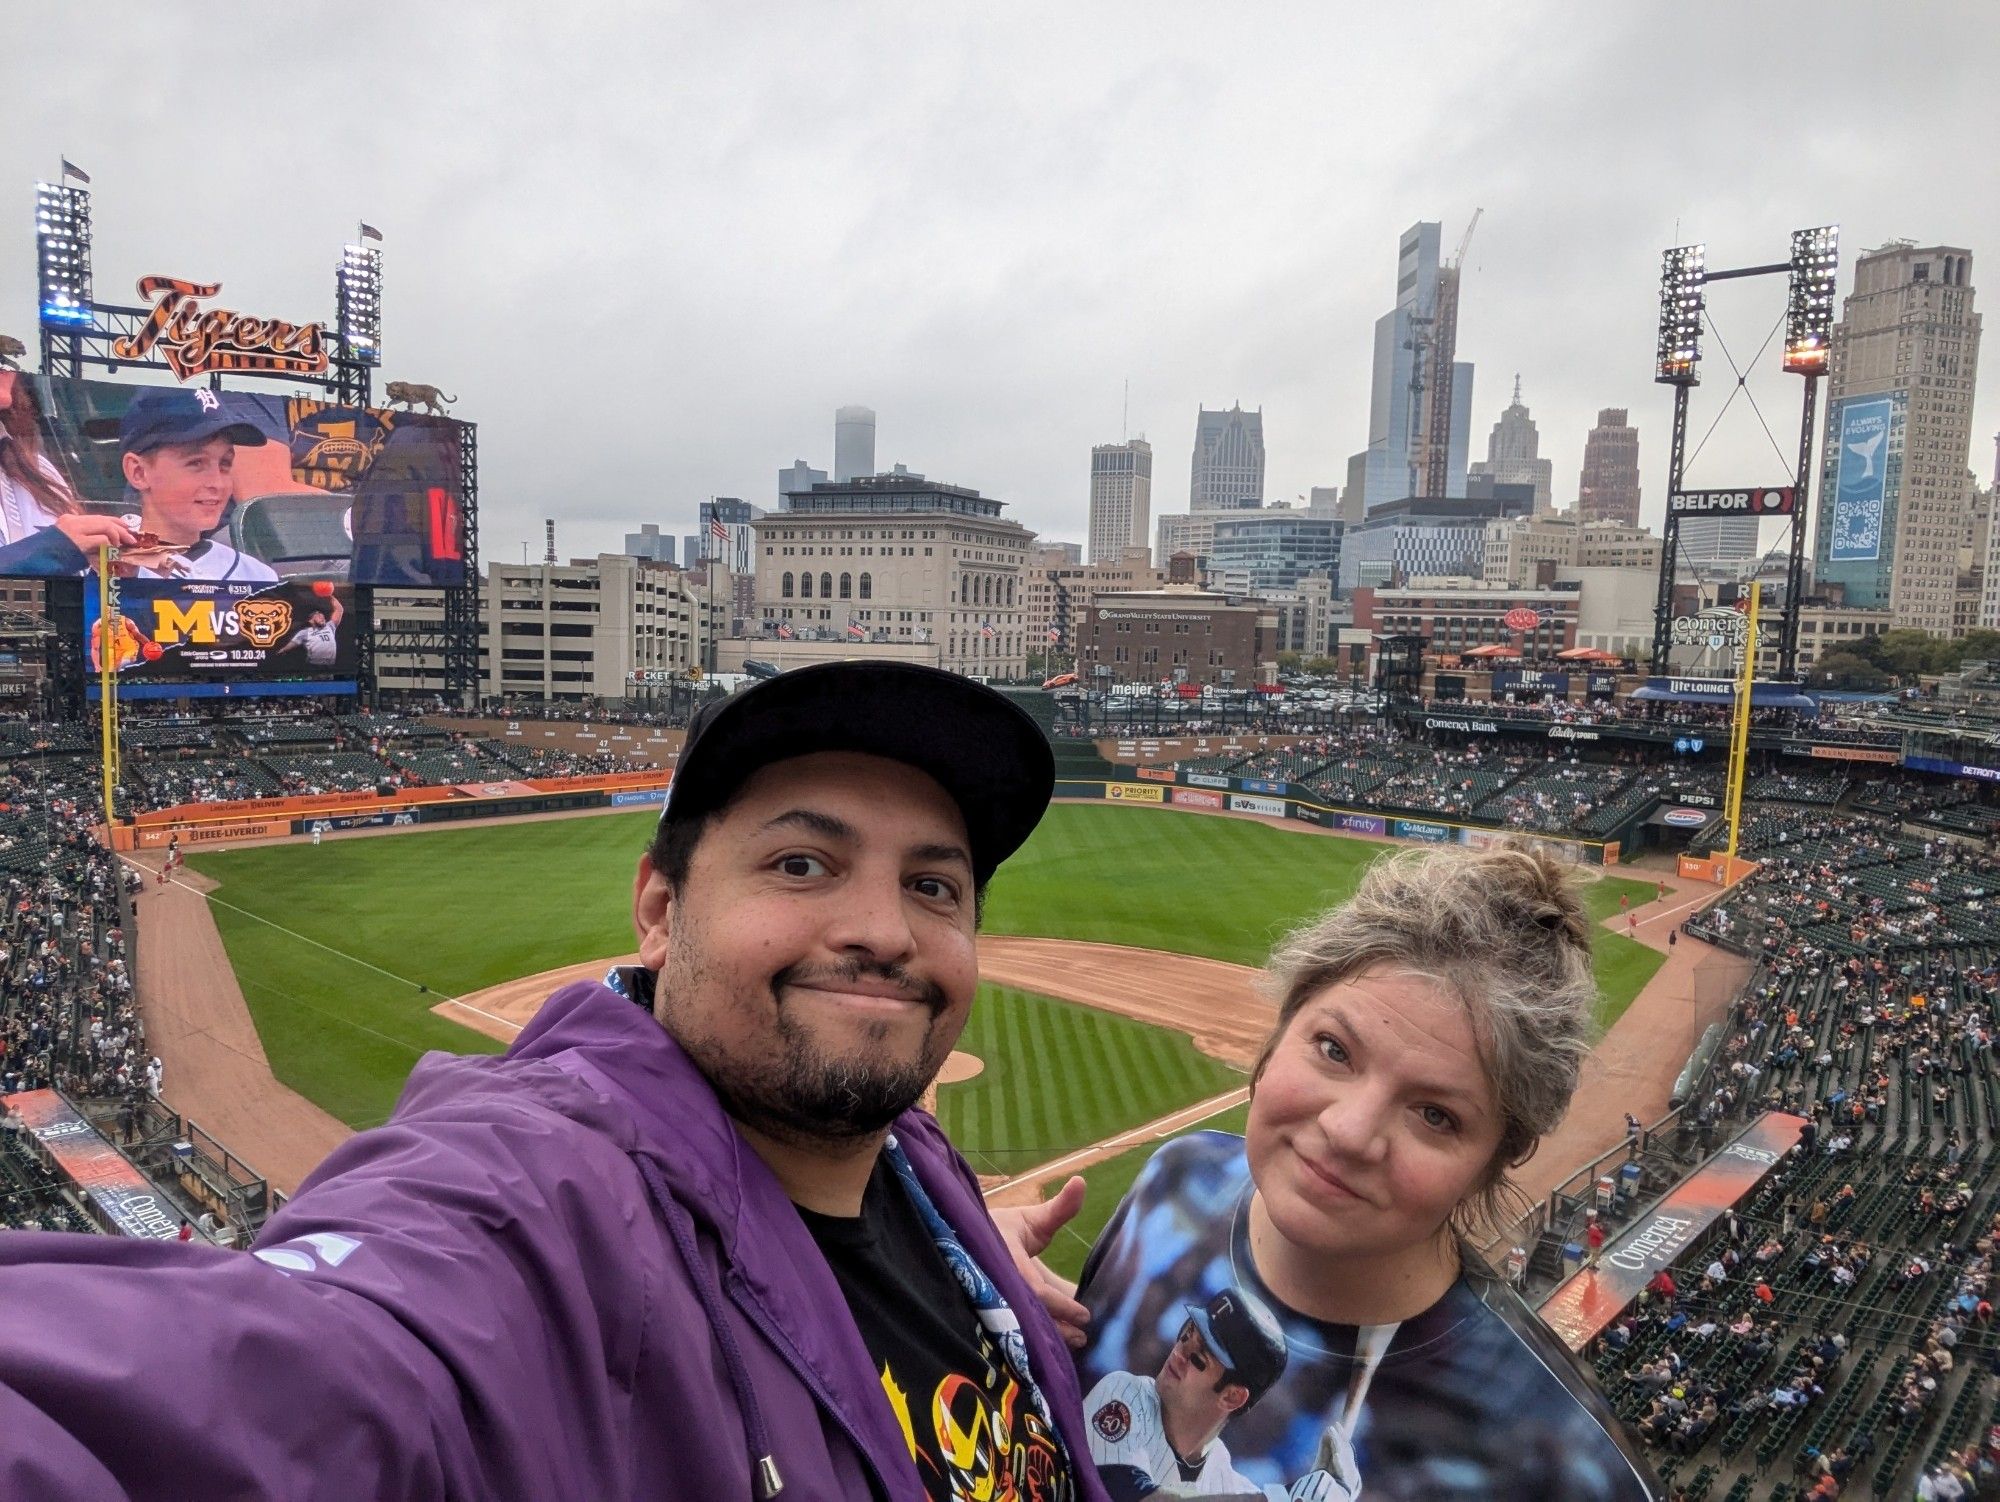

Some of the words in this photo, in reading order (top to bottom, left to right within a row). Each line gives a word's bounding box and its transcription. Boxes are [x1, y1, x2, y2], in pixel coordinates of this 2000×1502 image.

[113, 274, 325, 367] Tigers
[1672, 493, 1749, 510] BELFOR
[153, 600, 216, 643] M
[210, 611, 239, 636] VS
[231, 650, 266, 660] 10.20.24
[628, 671, 670, 680] ROCKET
[1521, 670, 1543, 684] Lite
[1112, 682, 1154, 698] meijer
[1670, 681, 1690, 693] Lite
[1691, 682, 1730, 694] LOUNGE
[1266, 693, 1285, 701] LAW
[509, 722, 519, 730] 23
[583, 724, 589, 732] 5
[1472, 722, 1498, 732] Bank
[1548, 726, 1577, 741] Bally
[1576, 732, 1598, 740] SPORTS
[636, 742, 641, 750] 3
[1962, 765, 1994, 778] DETROIT
[1201, 778, 1227, 786] CLIFFS
[1125, 787, 1159, 795] PRIORITY
[251, 801, 285, 809] DELIVERY
[1680, 794, 1714, 805] PEPSI
[1256, 805, 1281, 813] VISION
[1341, 816, 1377, 832] xfinity
[1412, 823, 1443, 834] McLaren
[1211, 1296, 1234, 1320] T
[1100, 1415, 1120, 1432] 50
